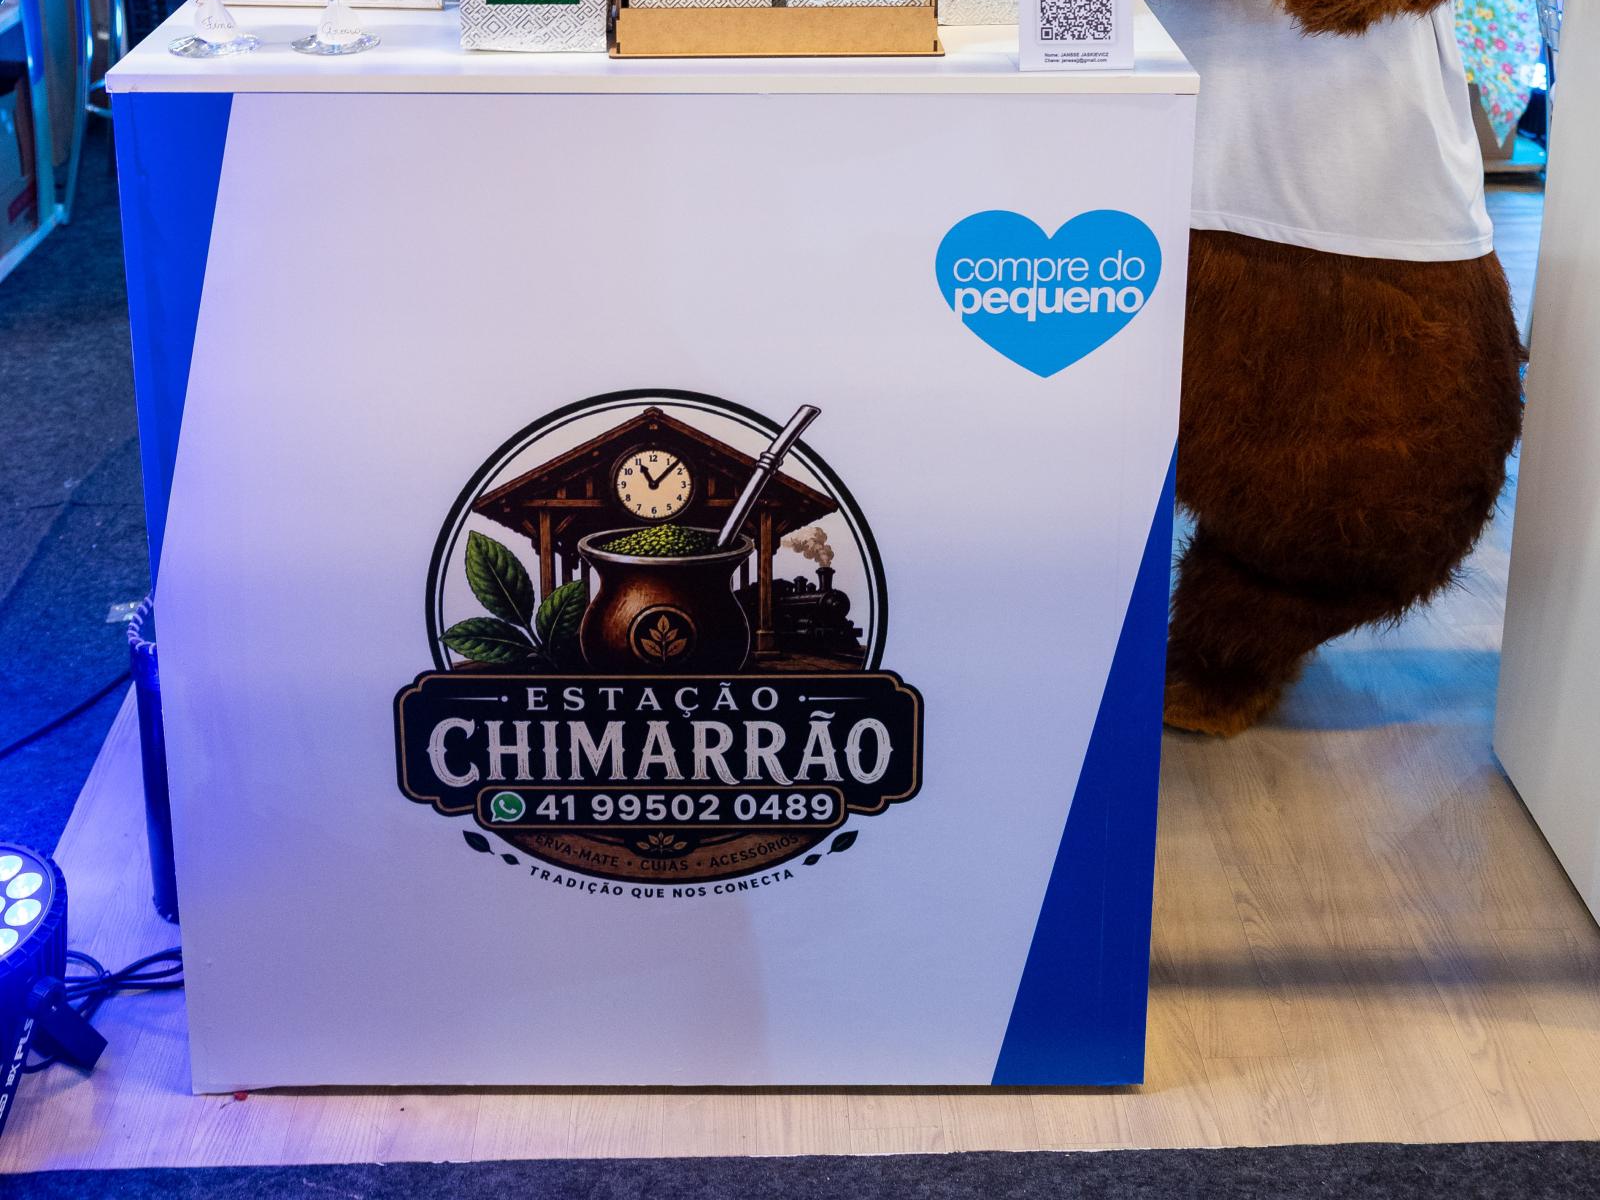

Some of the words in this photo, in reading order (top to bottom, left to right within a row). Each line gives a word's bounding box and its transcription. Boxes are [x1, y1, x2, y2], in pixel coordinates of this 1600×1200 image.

[953, 257, 1089, 287] compre
[1099, 250, 1146, 282] do
[954, 286, 1145, 322] pequeno
[649, 454, 658, 462] 12
[526, 682, 779, 718] ESTAÇÃO
[426, 710, 894, 788] CHIMARRÃO
[536, 794, 576, 821] 41
[592, 794, 721, 821] 99502
[733, 794, 834, 821] 0489
[535, 833, 620, 868] ERVA-MATE
[640, 860, 688, 872] CUIAS
[710, 832, 799, 869] ACESSÓRIOS
[529, 865, 623, 896] TRADIÇÃO
[631, 887, 665, 899] QUE
[672, 886, 707, 898] NOS
[713, 868, 795, 895] CONECTA
